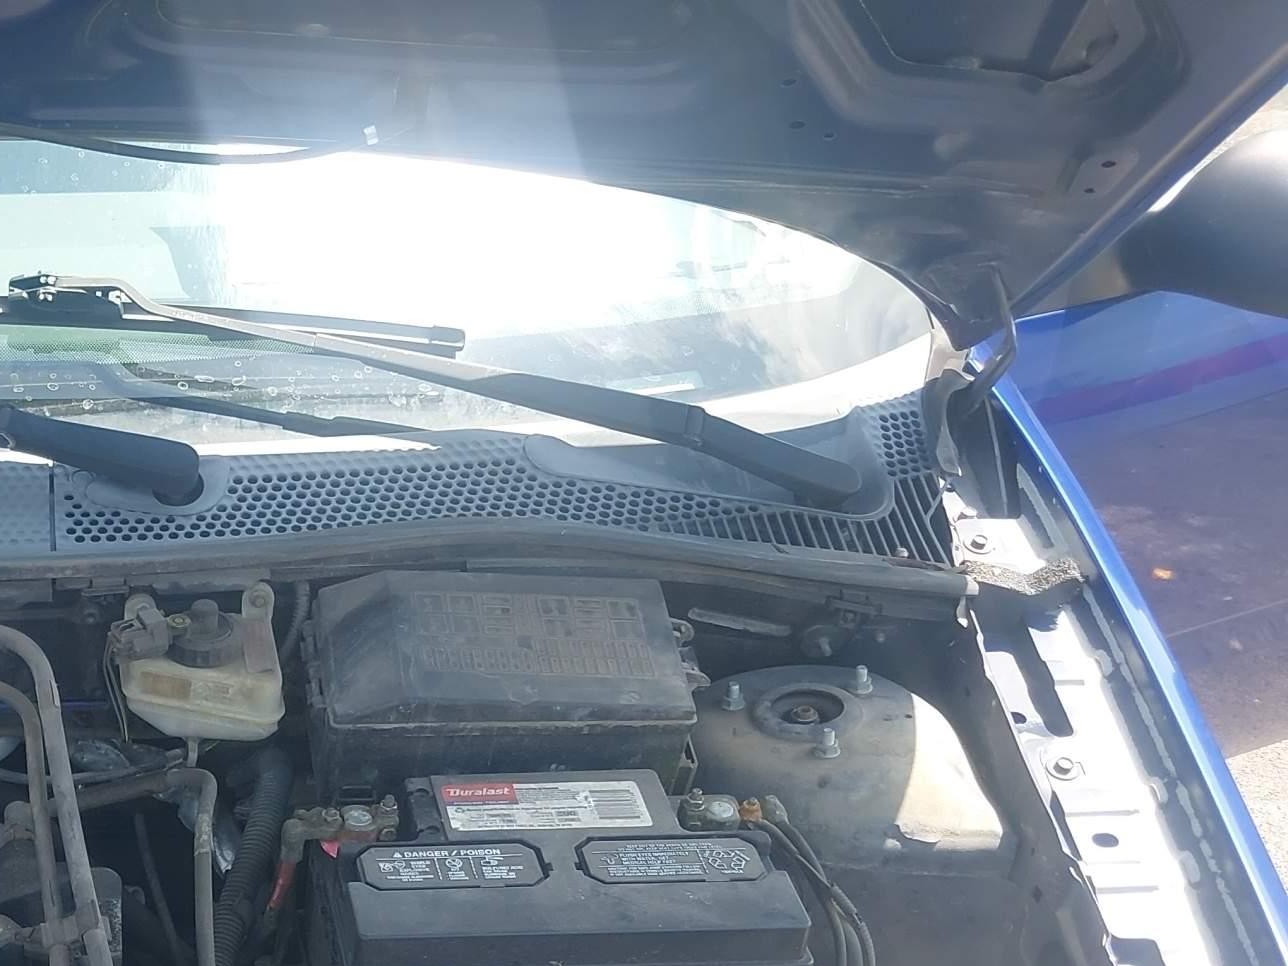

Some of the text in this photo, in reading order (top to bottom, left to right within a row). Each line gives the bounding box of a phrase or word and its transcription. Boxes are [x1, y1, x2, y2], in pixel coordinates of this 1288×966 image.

[446, 787, 511, 797] Duralast
[404, 850, 449, 858] DANGER
[460, 848, 501, 856] POISON
